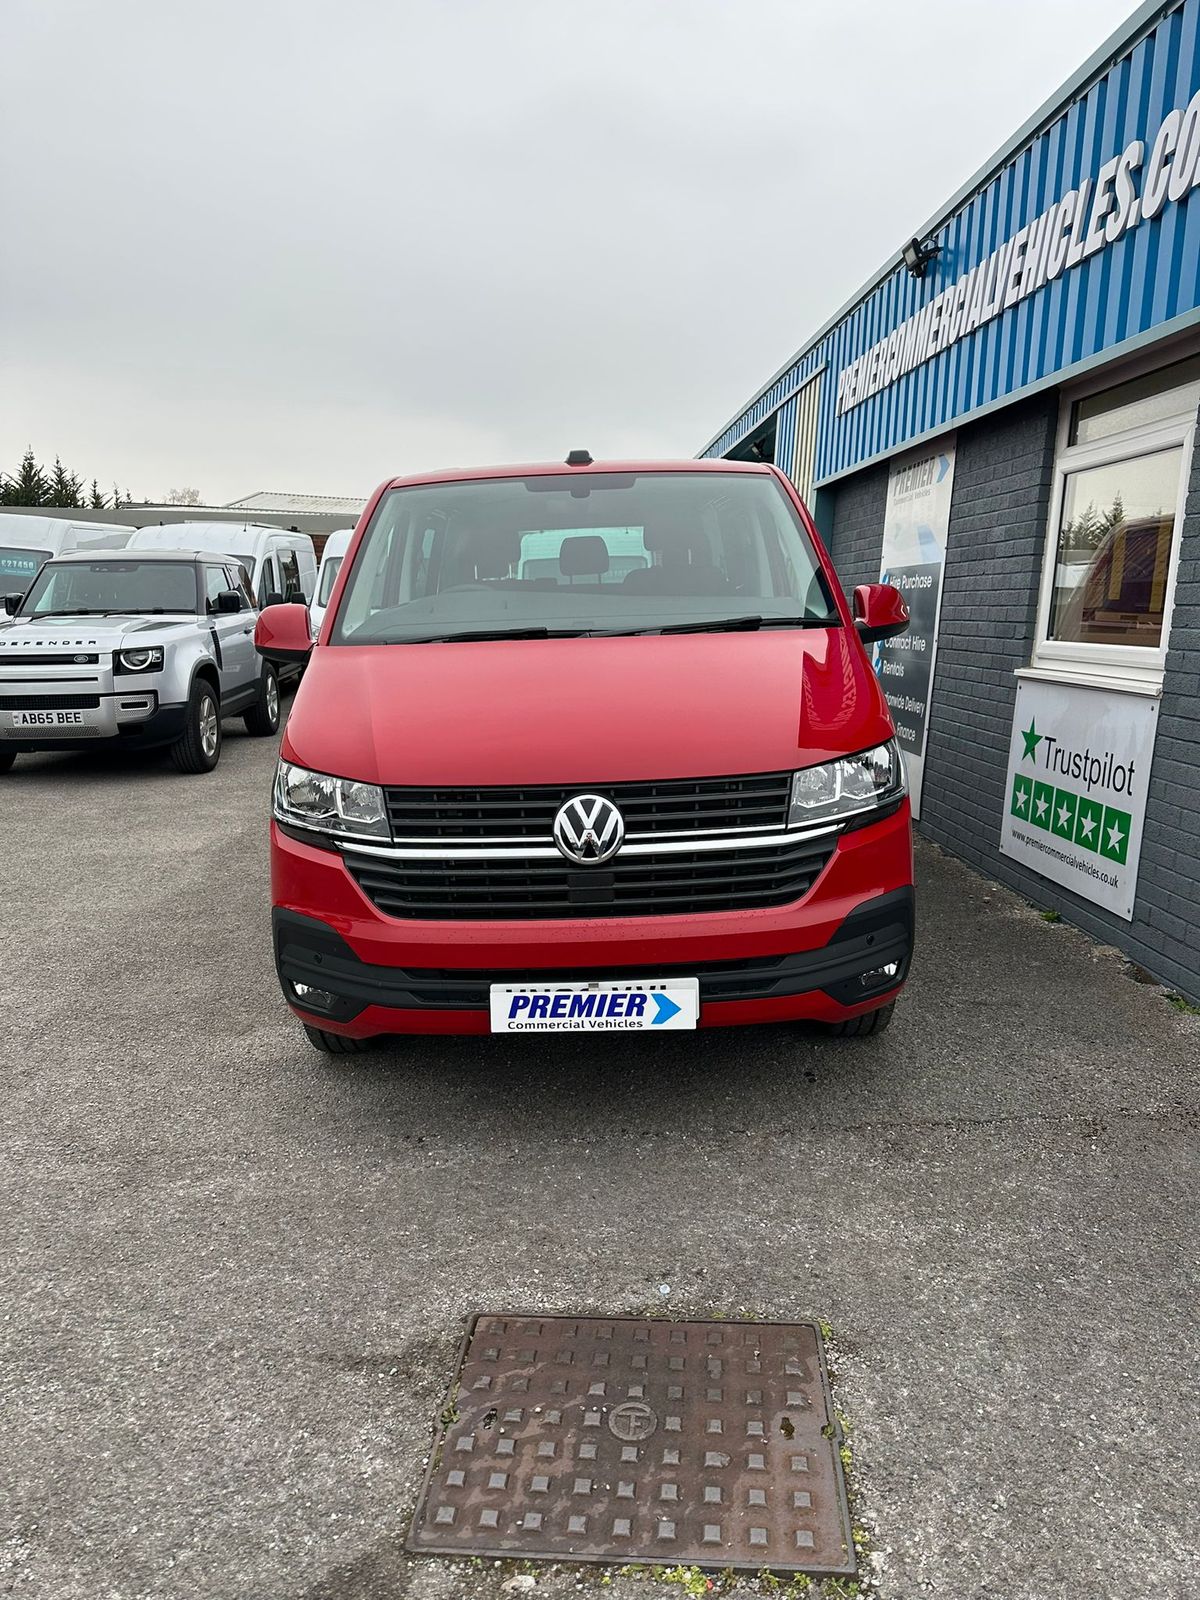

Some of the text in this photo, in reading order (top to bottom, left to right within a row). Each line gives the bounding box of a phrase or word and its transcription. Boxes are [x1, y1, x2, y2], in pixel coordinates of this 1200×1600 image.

[835, 88, 1200, 418] PREMIERCOMMERCIALVEHICLES.CO
[893, 456, 936, 497] PREMIER
[901, 574, 933, 589] Purchase
[912, 635, 926, 651] Hire
[882, 660, 905, 677] Rentals
[905, 696, 926, 717] Delivery
[21, 713, 54, 725] AB65
[57, 711, 82, 724] BEE
[896, 722, 916, 741] Finance
[1044, 736, 1136, 796] Trustpilot
[1011, 829, 1119, 889] www.premiercommercialvehicles.co.uk
[508, 993, 648, 1019] PREMIER
[507, 1018, 644, 1030] Commercial Vehicles
